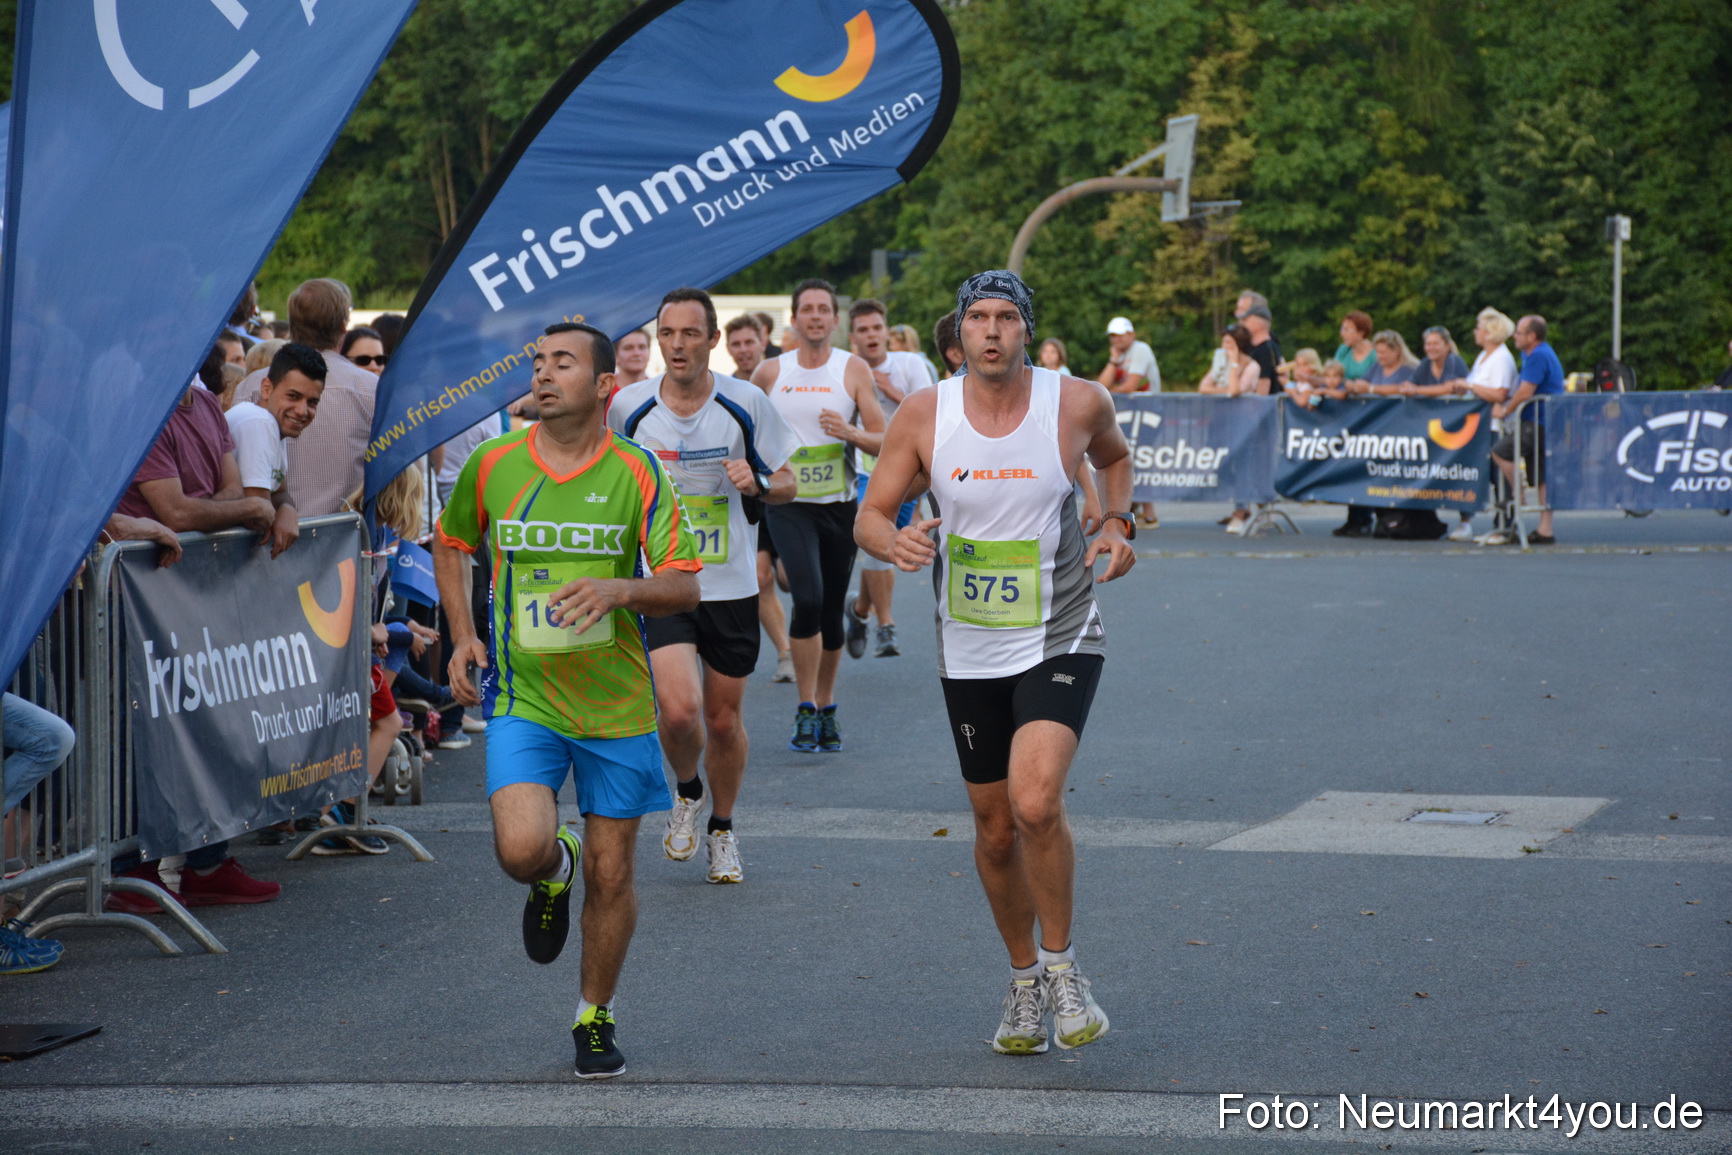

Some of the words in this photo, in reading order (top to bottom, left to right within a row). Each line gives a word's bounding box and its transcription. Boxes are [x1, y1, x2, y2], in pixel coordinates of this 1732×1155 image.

[692, 172, 773, 227] Druck
[776, 147, 829, 183] und
[828, 91, 925, 160] Medien
[468, 109, 811, 312] Frischmann
[1128, 438, 1229, 470] ischer
[1286, 428, 1428, 461] Frischmann
[800, 465, 833, 483] 552
[973, 469, 1038, 480] KLEBL
[1132, 472, 1218, 487] UTOMOBILE
[1366, 461, 1401, 477] Druck
[1403, 462, 1428, 479] und
[1429, 463, 1479, 480] Medien
[499, 521, 626, 553] BOCK
[963, 573, 1019, 603] 575
[143, 627, 317, 718] Frischmann
[251, 702, 294, 743] Druck
[295, 694, 323, 734] und
